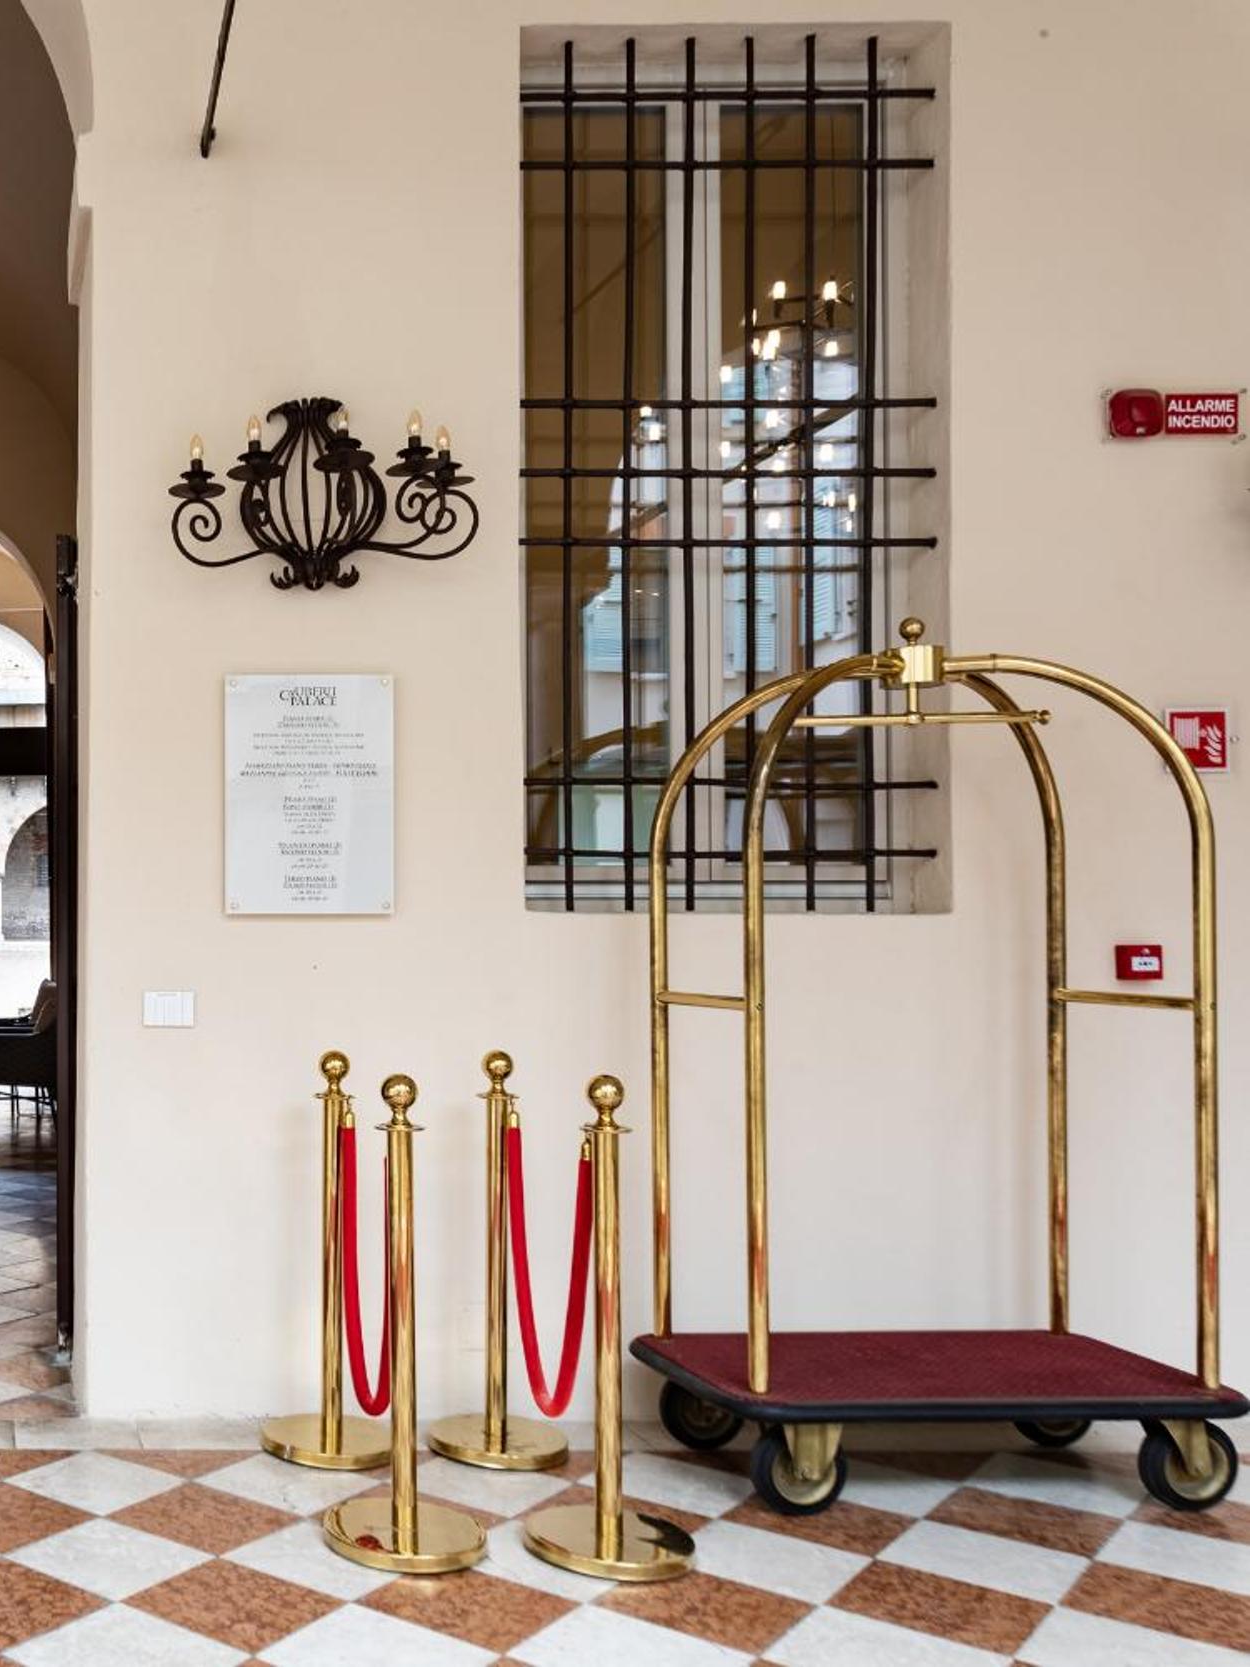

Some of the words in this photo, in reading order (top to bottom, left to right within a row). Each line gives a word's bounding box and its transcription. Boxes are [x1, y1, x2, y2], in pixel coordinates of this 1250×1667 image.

[1167, 399, 1236, 412] ALLARME
[1167, 415, 1236, 428] INCENDIO
[290, 696, 338, 706] PALACE
